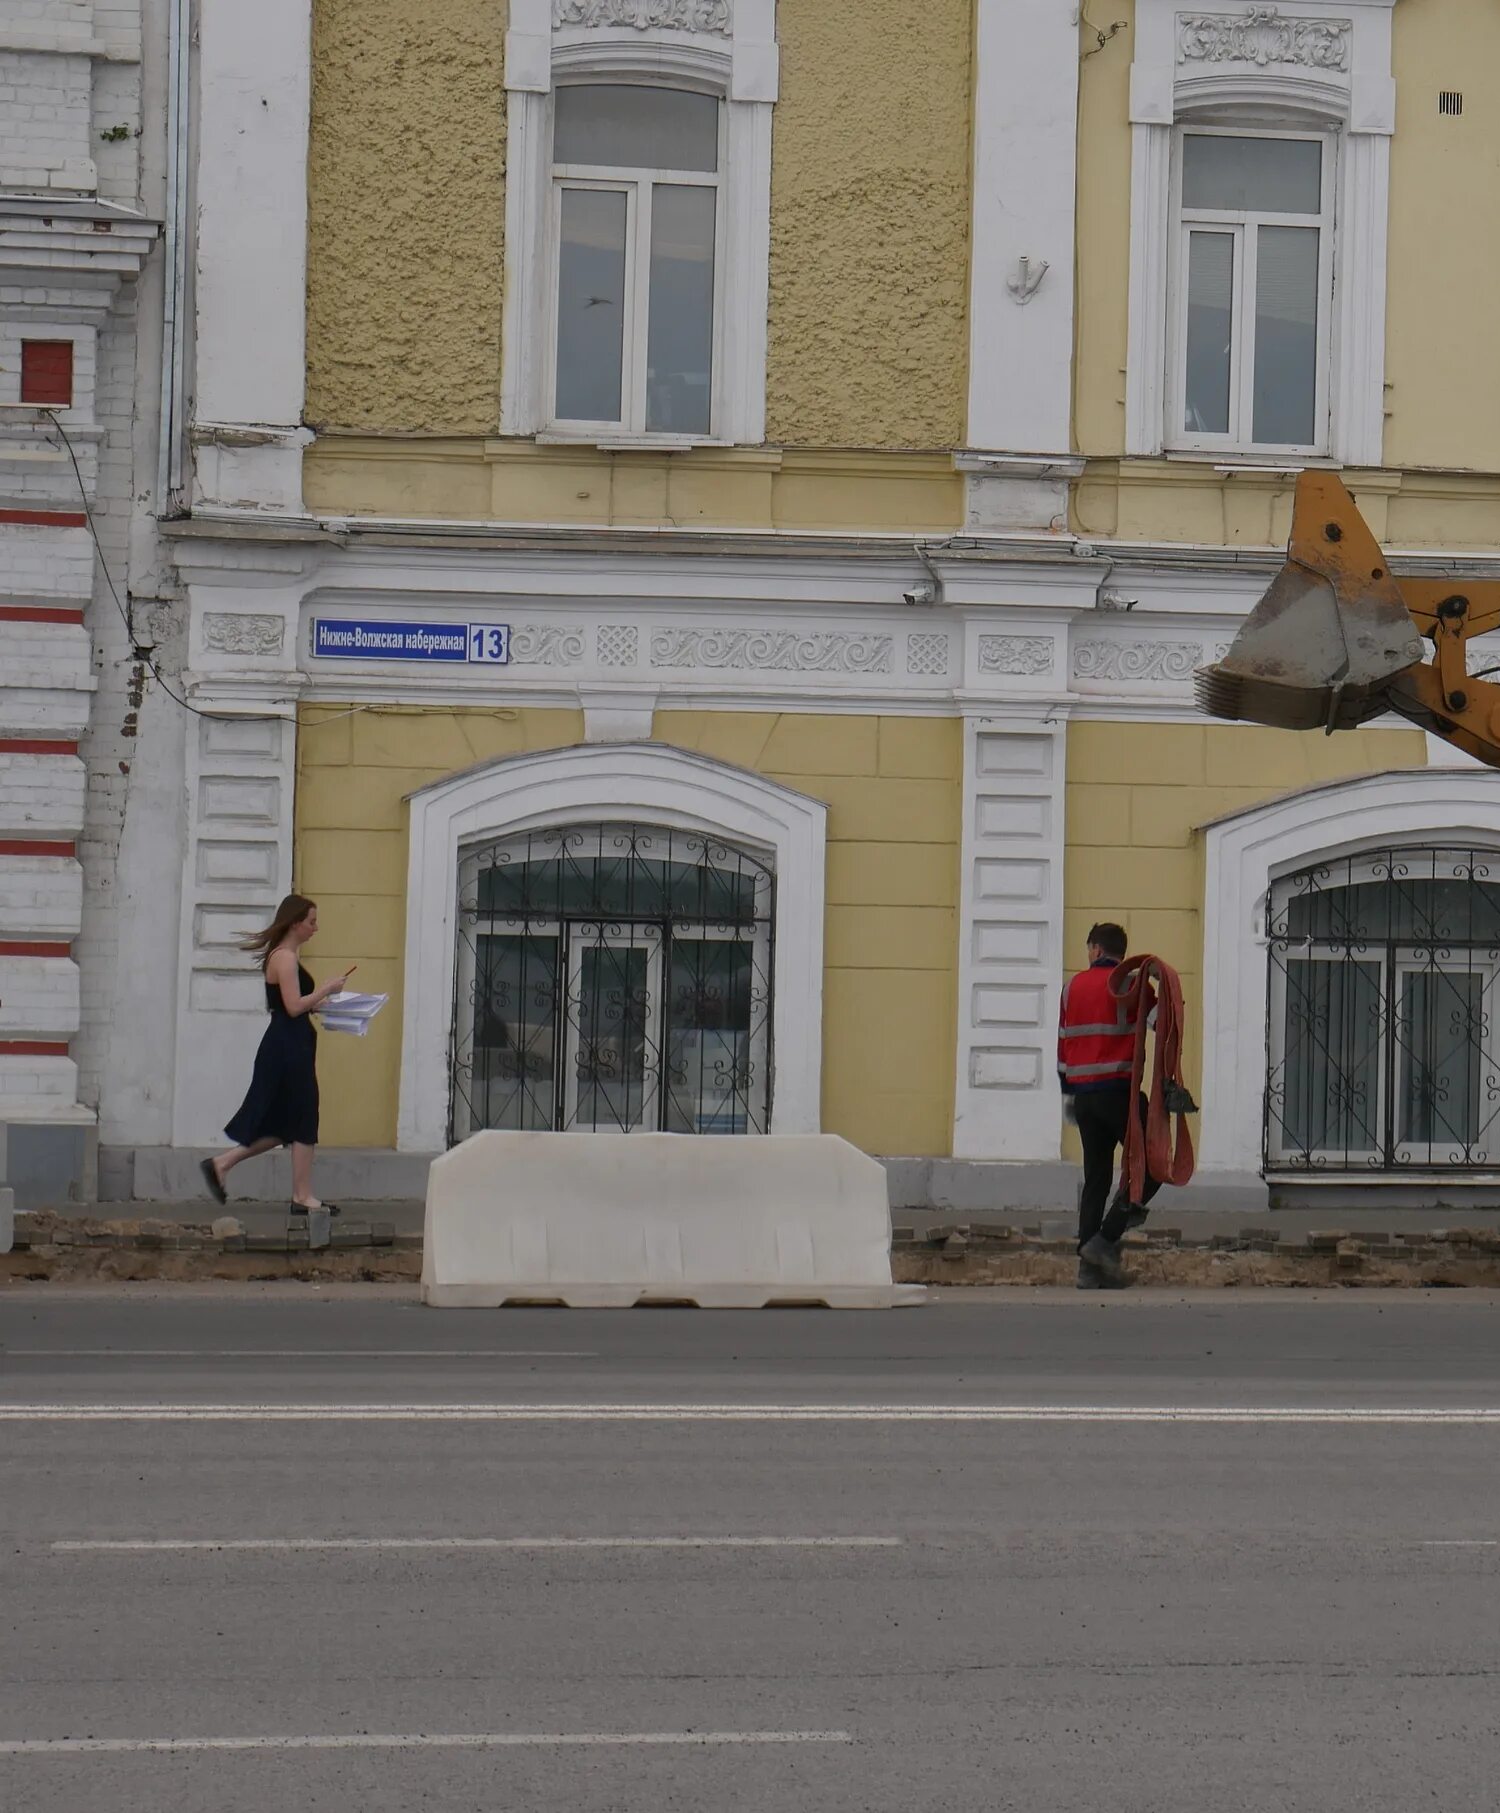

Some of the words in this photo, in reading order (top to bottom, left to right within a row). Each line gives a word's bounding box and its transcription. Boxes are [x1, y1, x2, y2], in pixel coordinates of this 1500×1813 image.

[320, 626, 403, 648] Нижне-Волжская
[405, 629, 464, 654] набережная
[472, 629, 504, 659] 13
